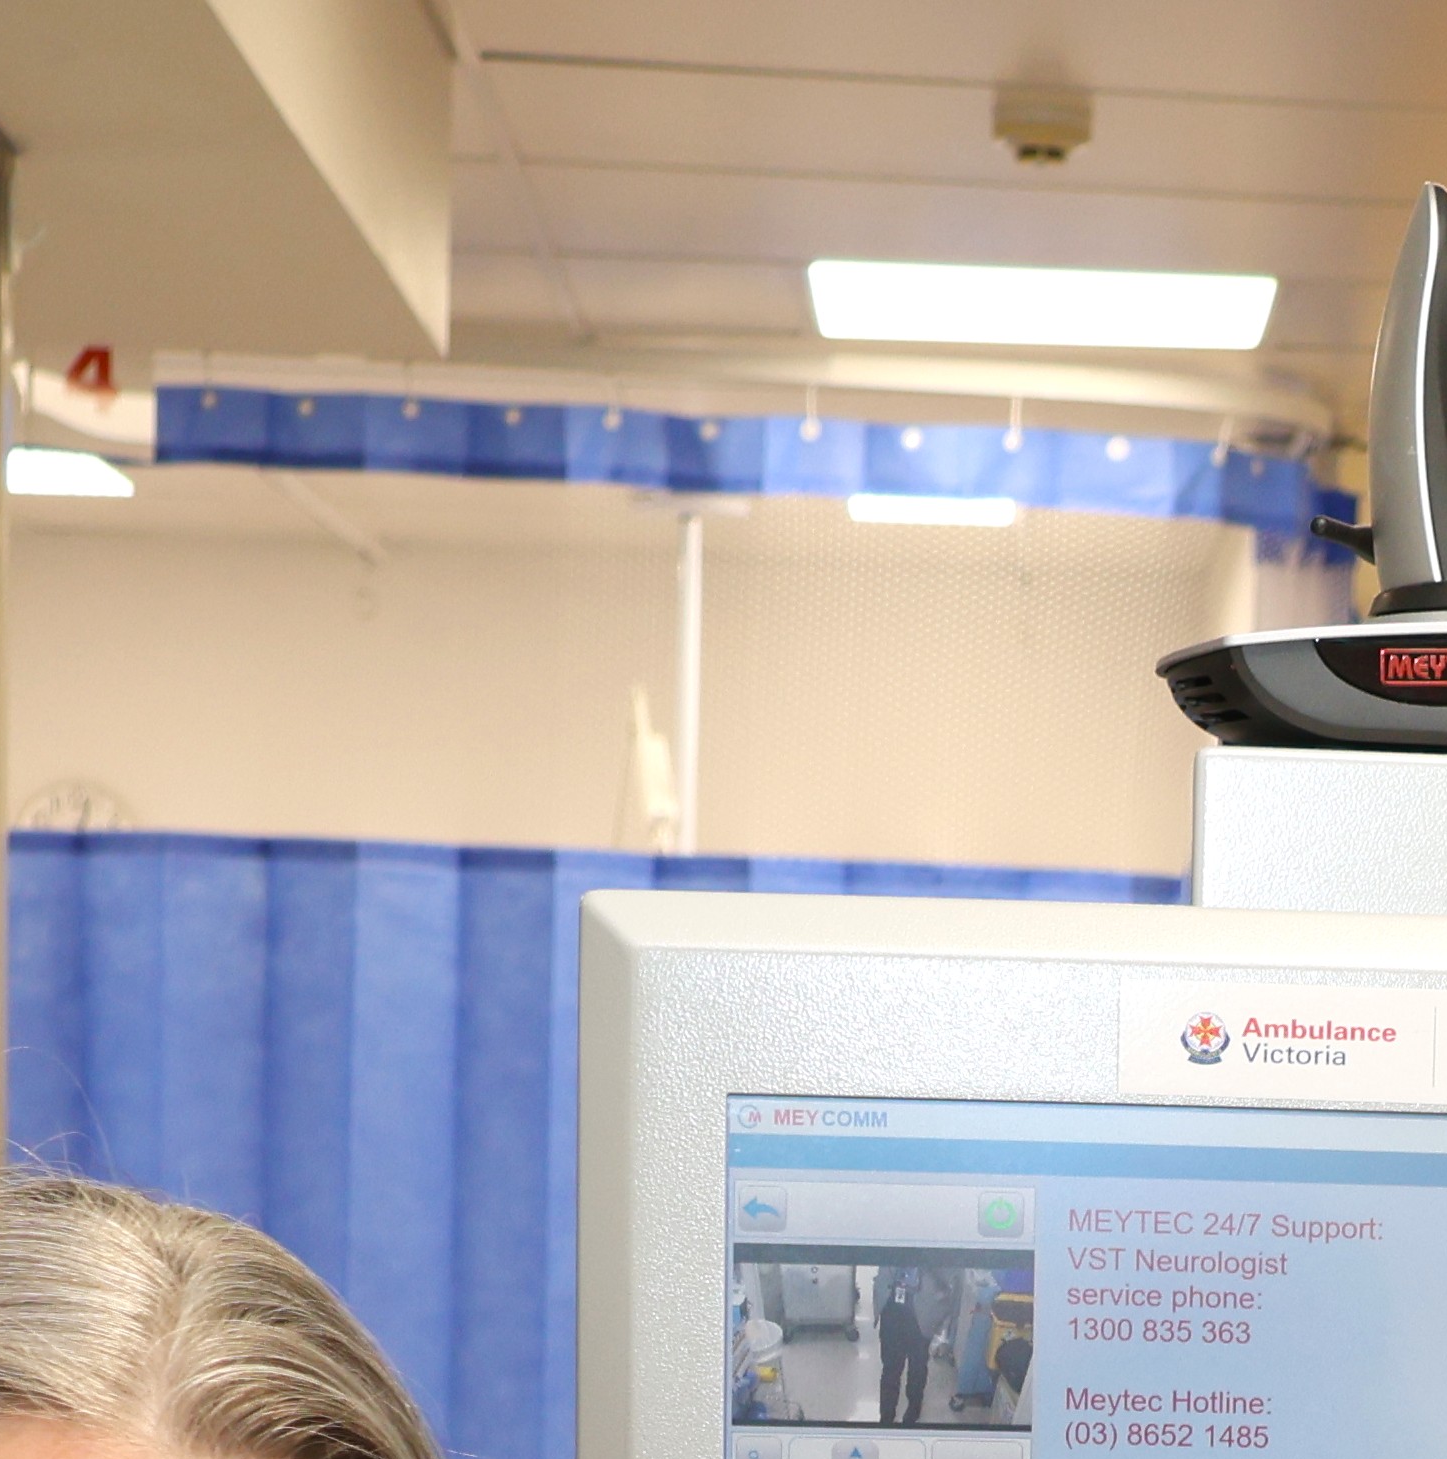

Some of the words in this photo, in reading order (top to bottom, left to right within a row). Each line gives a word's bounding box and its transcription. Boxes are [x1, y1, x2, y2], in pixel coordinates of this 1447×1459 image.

[1241, 1016, 1398, 1044] Ambulance
[1242, 1042, 1347, 1066] Victoria
[1066, 1208, 1194, 1237] MEYTEC
[1200, 1210, 1261, 1239] 24/7
[1270, 1213, 1385, 1244] Support:
[1066, 1247, 1127, 1273] VST
[1134, 1248, 1289, 1280] Neurologist
[1066, 1283, 1163, 1308] service
[1170, 1285, 1264, 1315] phone:
[1067, 1316, 1135, 1343] 1300
[1141, 1317, 1194, 1345] 835
[1200, 1319, 1253, 1345] 363
[1064, 1387, 1163, 1418] Meytec
[1170, 1389, 1273, 1416] Hotline:
[1064, 1421, 1119, 1451] (03)
[1126, 1422, 1194, 1449] 8652
[1203, 1423, 1270, 1451] 1485
